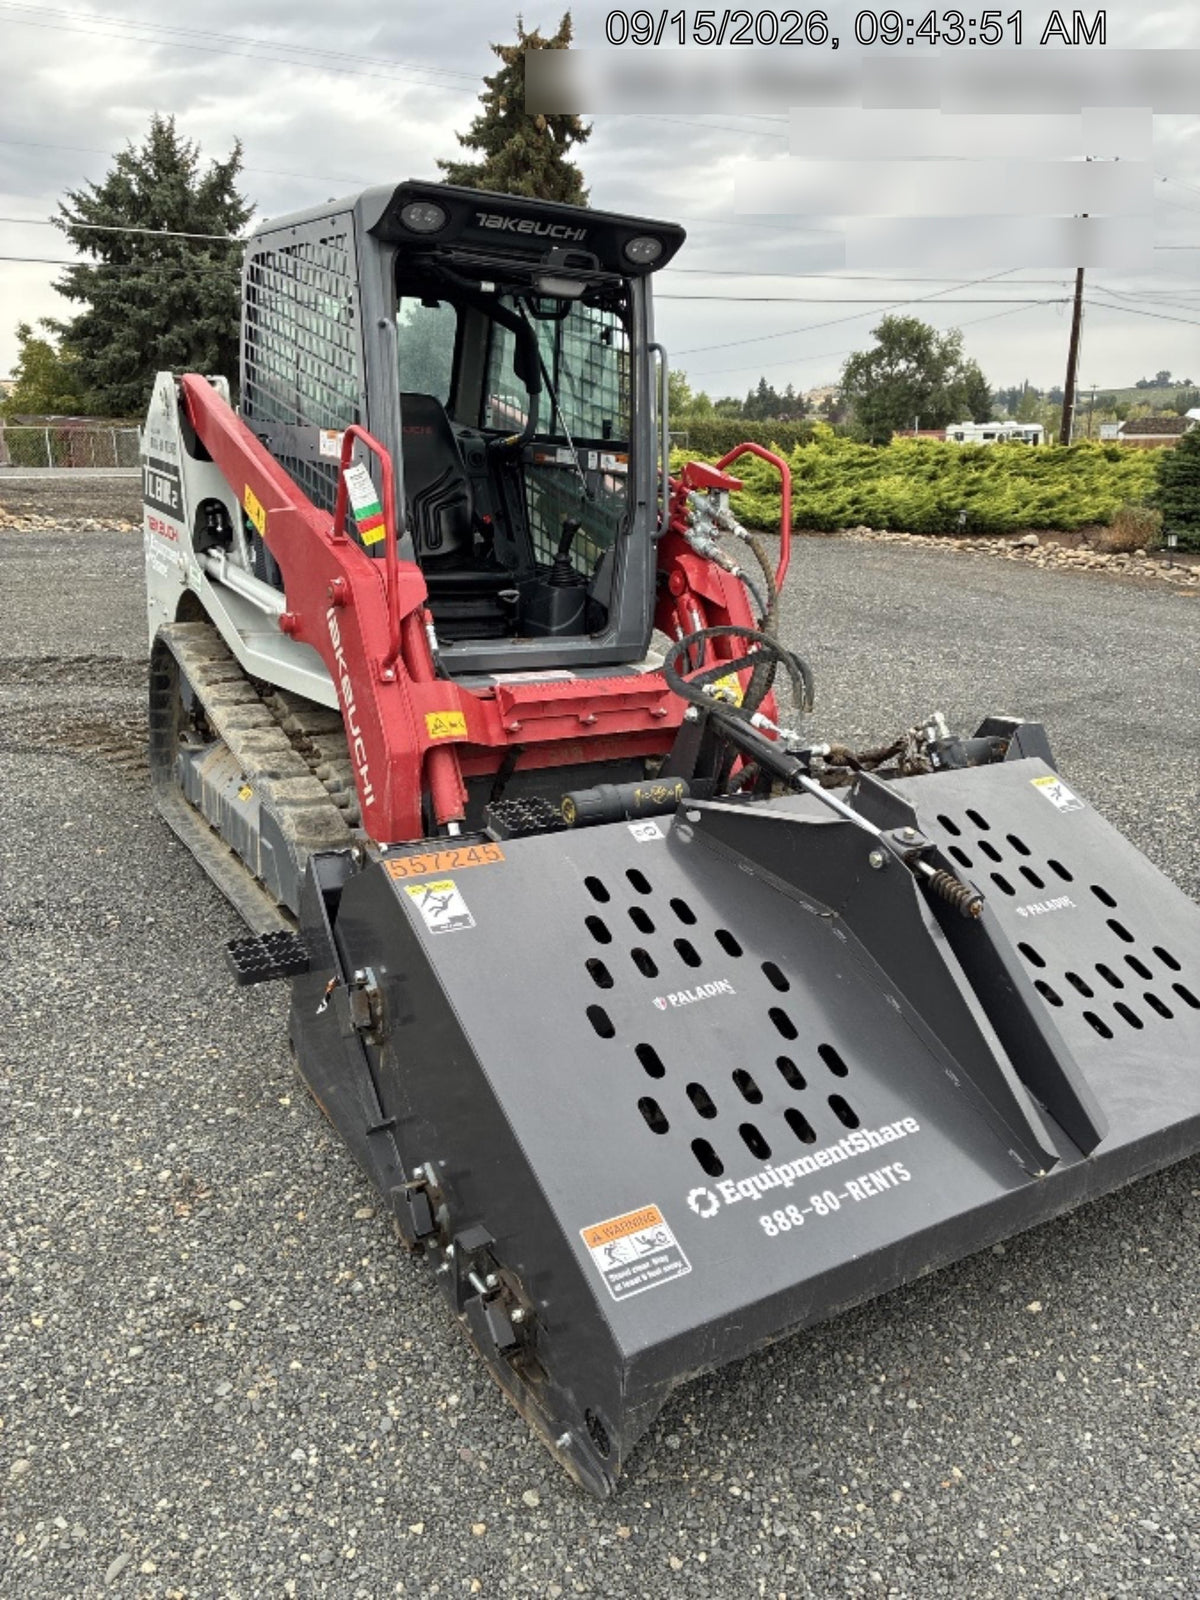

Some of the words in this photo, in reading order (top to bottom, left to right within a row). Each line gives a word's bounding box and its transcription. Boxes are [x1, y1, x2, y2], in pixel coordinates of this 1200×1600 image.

[476, 212, 587, 241] TAKEUCHI
[389, 845, 501, 878] 557245
[666, 978, 736, 1008] PALADIN
[715, 1116, 921, 1206] EquipmentShare
[758, 1161, 912, 1237] 888-80-RENTS
[603, 1211, 657, 1239] WARNING
